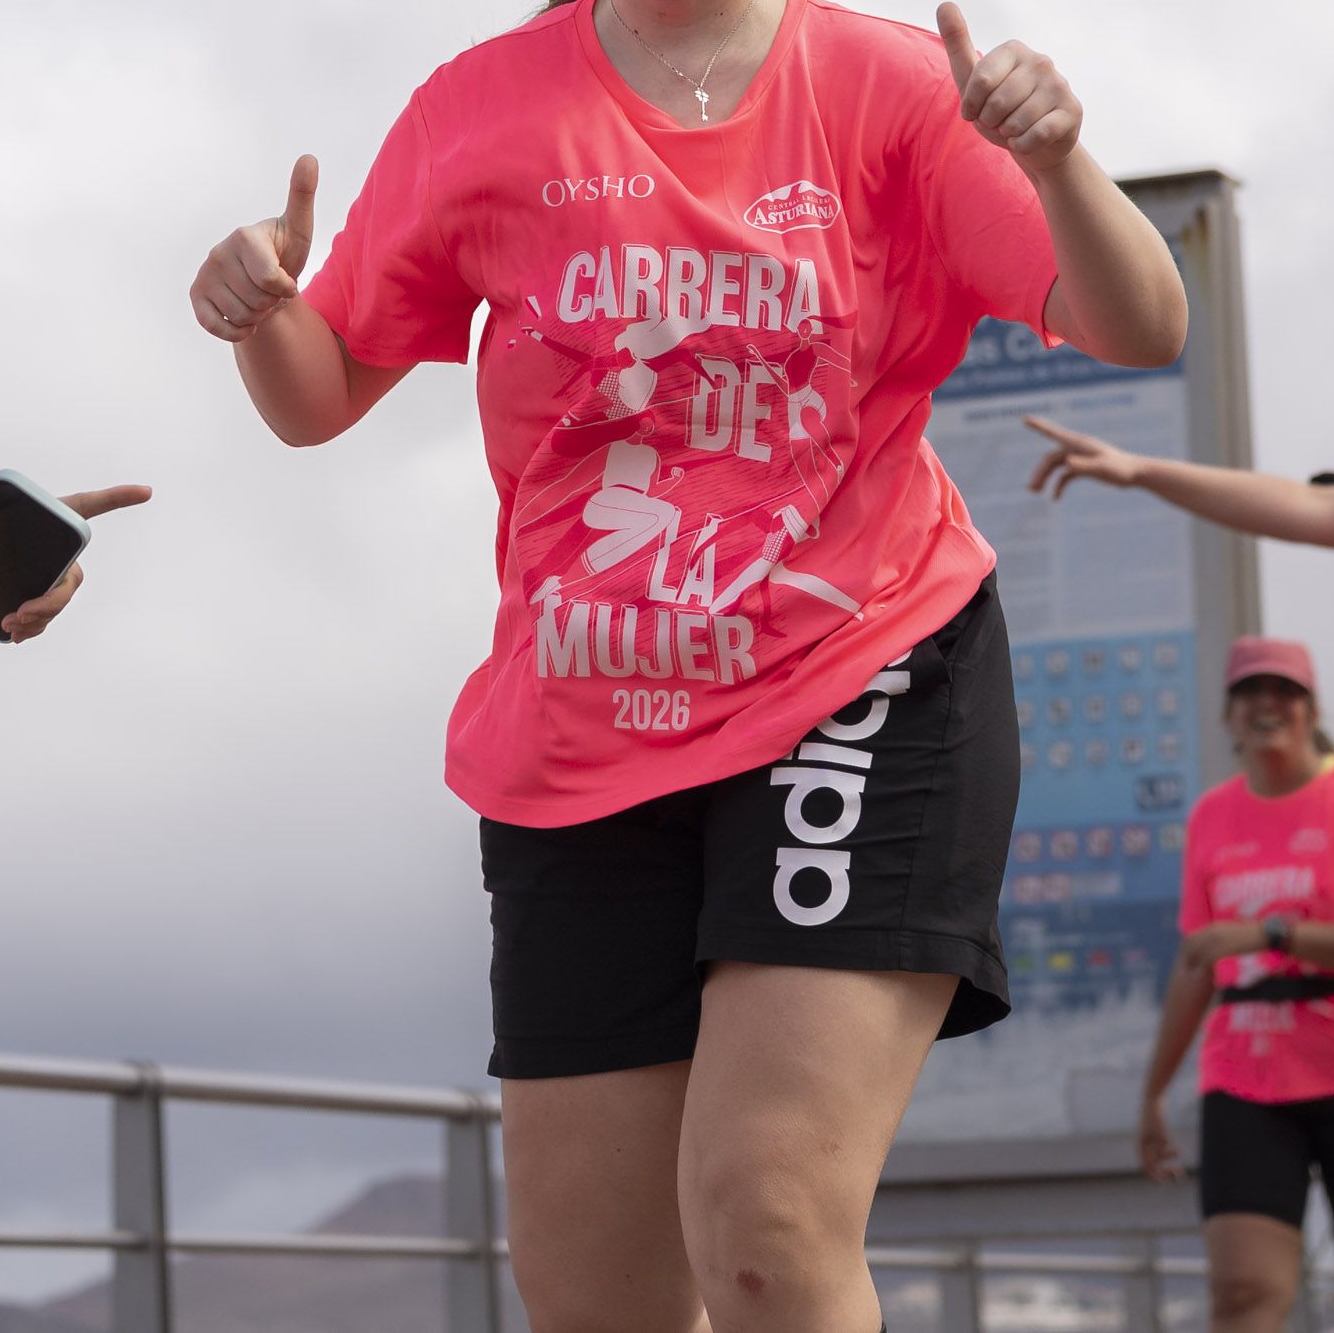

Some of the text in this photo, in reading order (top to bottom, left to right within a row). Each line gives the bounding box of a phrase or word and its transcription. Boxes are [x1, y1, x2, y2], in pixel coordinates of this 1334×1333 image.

[542, 174, 656, 207] OYSHO
[753, 203, 834, 225] ASTURIANA
[556, 243, 824, 335] CARRERA
[684, 352, 784, 463] DE
[645, 506, 722, 607] LA
[537, 592, 758, 685] MUJER
[612, 689, 691, 732] 2026
